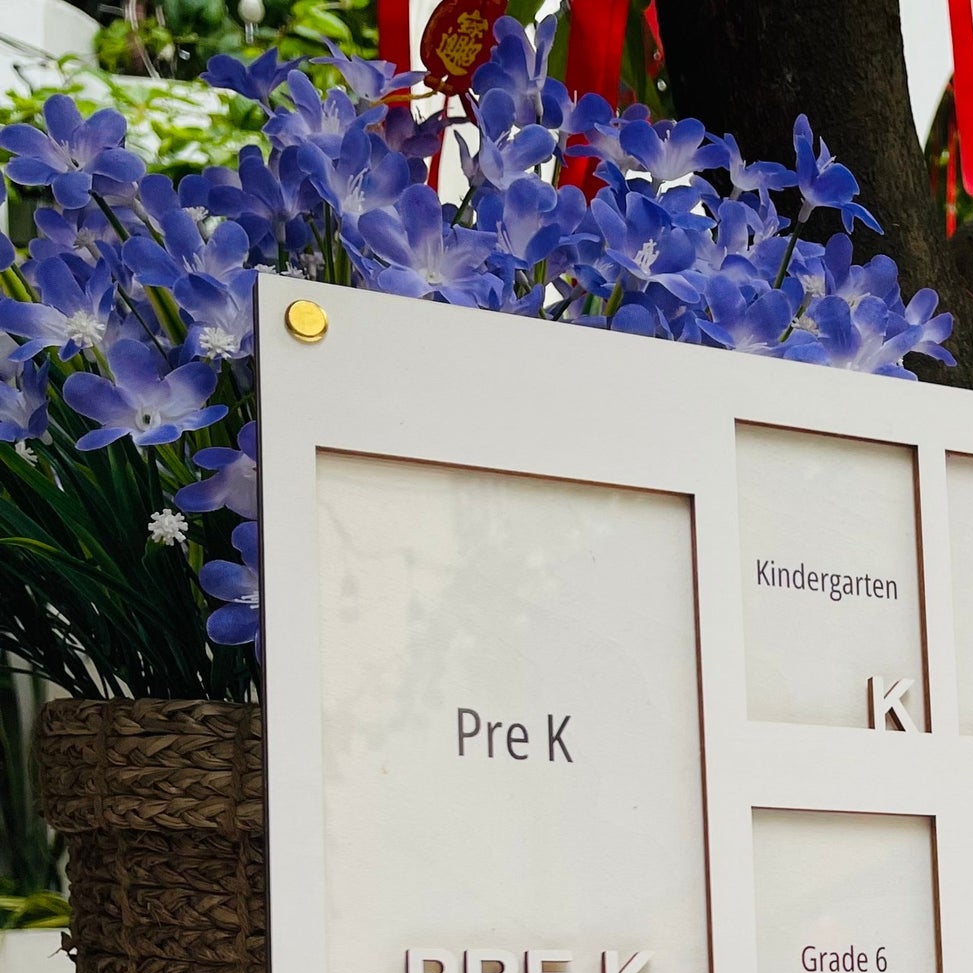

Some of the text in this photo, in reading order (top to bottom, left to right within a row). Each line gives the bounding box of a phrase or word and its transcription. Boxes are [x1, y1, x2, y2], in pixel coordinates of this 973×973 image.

[756, 559, 898, 602] Kindergarten
[867, 676, 919, 732] K
[457, 707, 574, 764] Pre K
[801, 944, 888, 973] Grade 6
